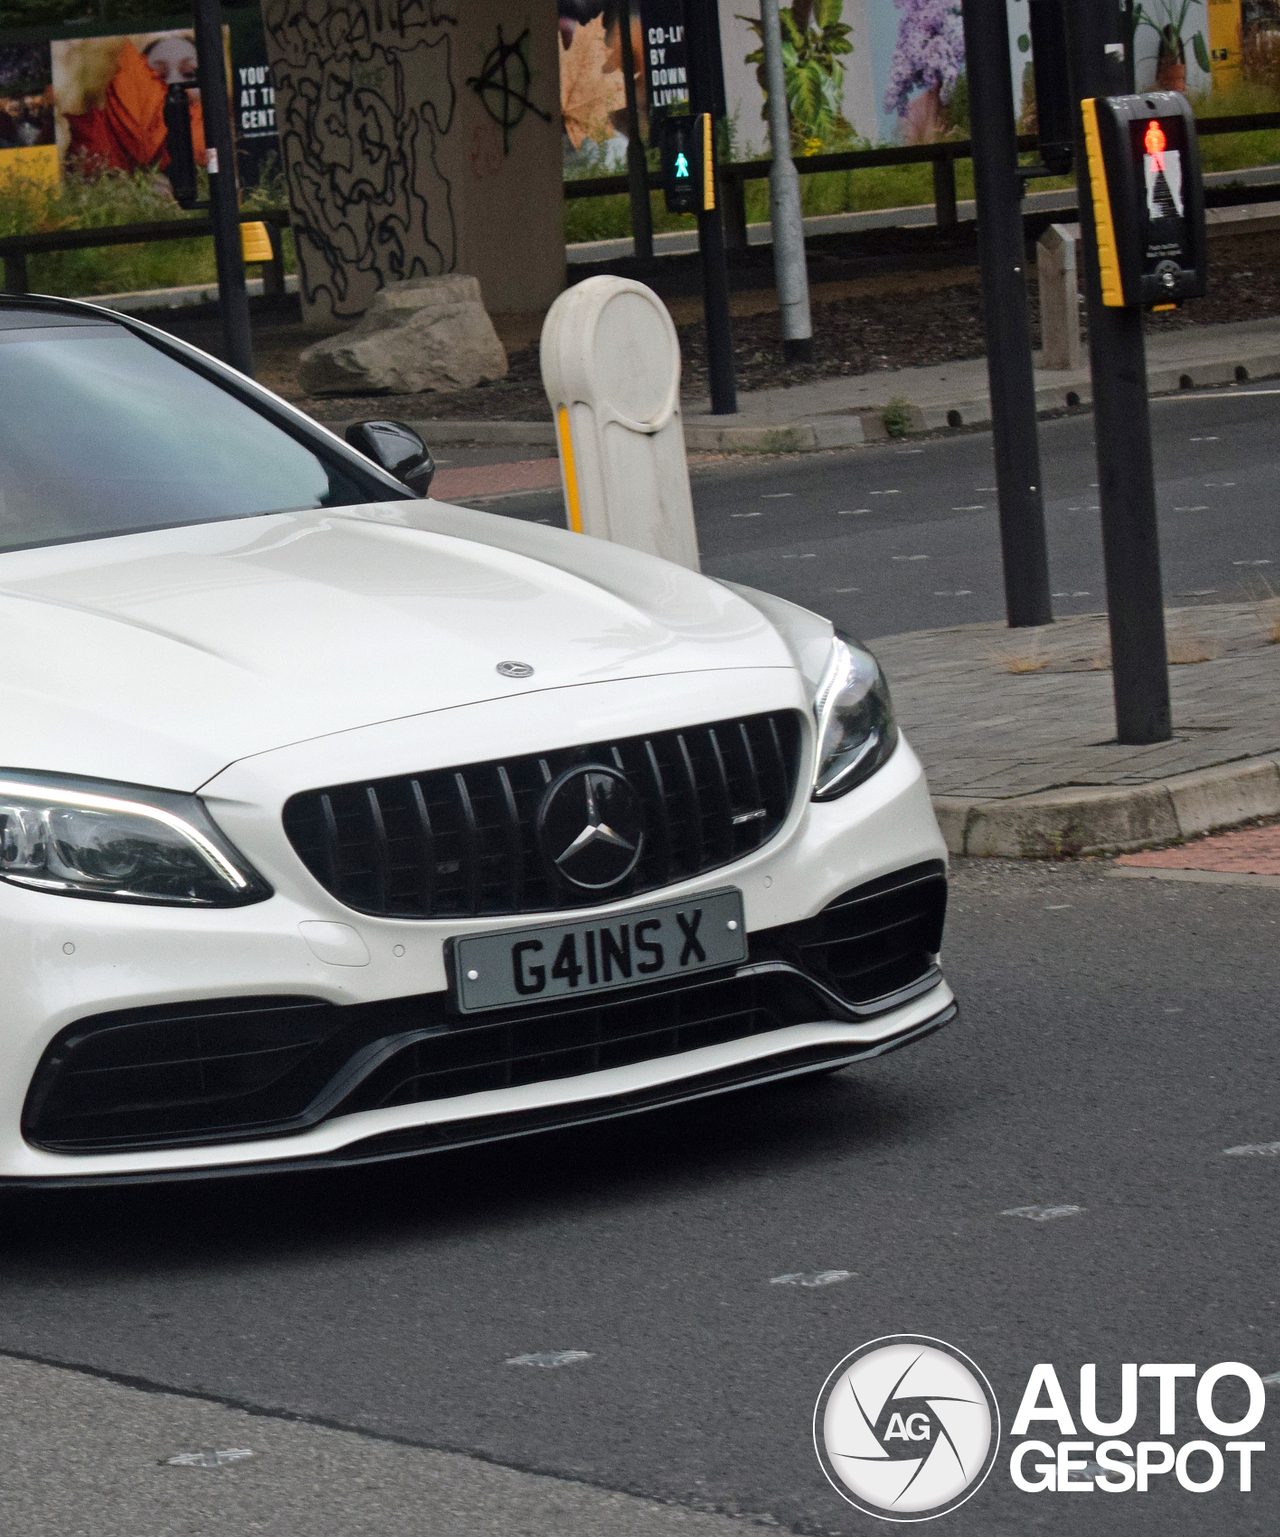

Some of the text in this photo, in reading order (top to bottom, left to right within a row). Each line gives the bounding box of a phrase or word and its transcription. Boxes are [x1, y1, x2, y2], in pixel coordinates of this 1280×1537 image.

[649, 47, 667, 66] BY
[651, 66, 688, 87] DOWN
[241, 88, 257, 107] AT
[241, 108, 276, 129] CENT
[676, 908, 708, 967] X
